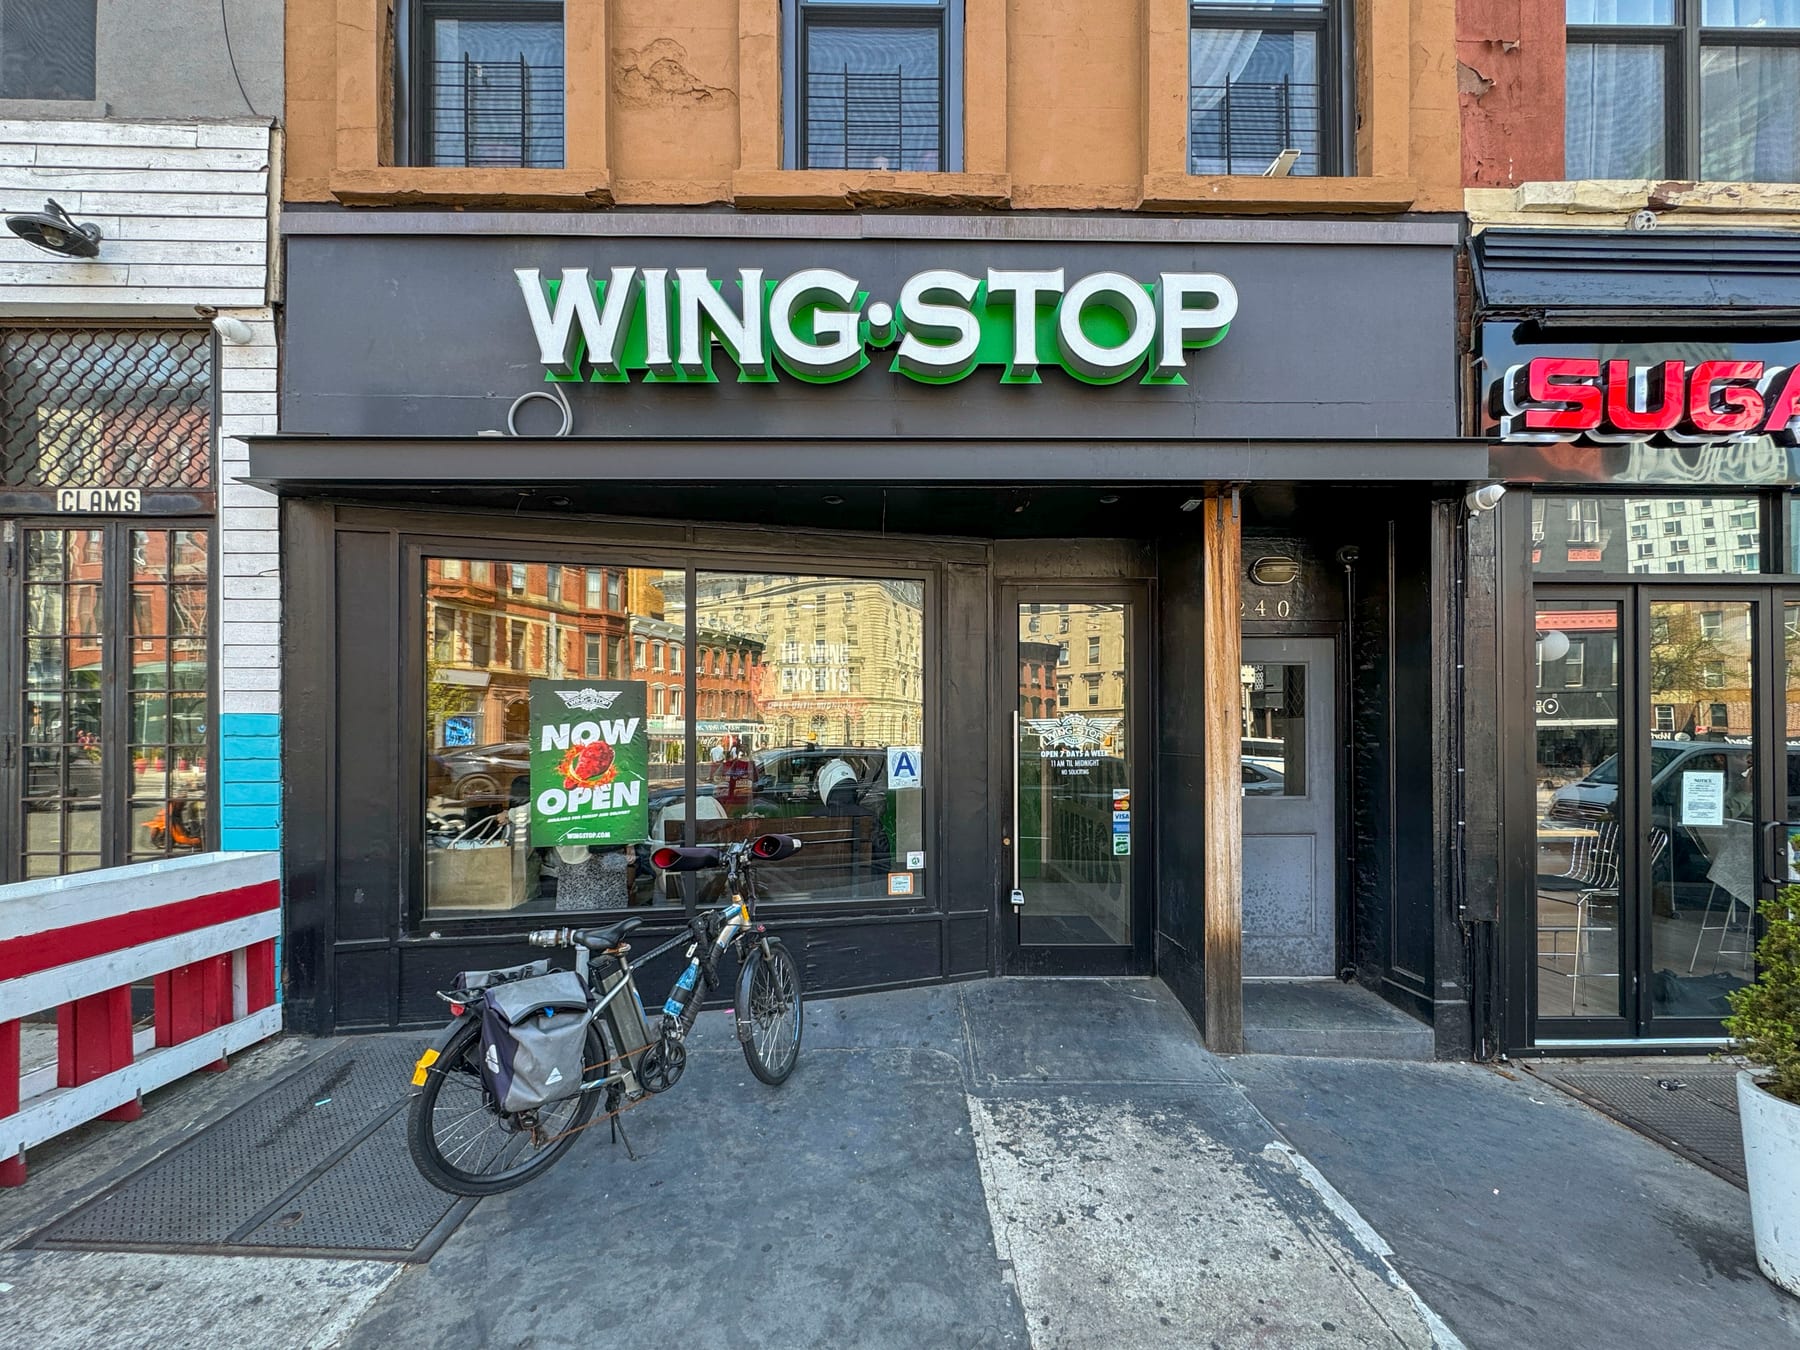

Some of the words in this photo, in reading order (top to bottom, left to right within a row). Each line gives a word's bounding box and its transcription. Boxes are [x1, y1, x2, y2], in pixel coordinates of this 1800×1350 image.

[62, 490, 137, 512] CLAMS
[781, 643, 805, 664] THE
[810, 643, 849, 665] WING
[782, 667, 849, 692] EXPERTS
[541, 717, 640, 752] NOW
[893, 751, 916, 777] A
[536, 780, 641, 816] OPEN
